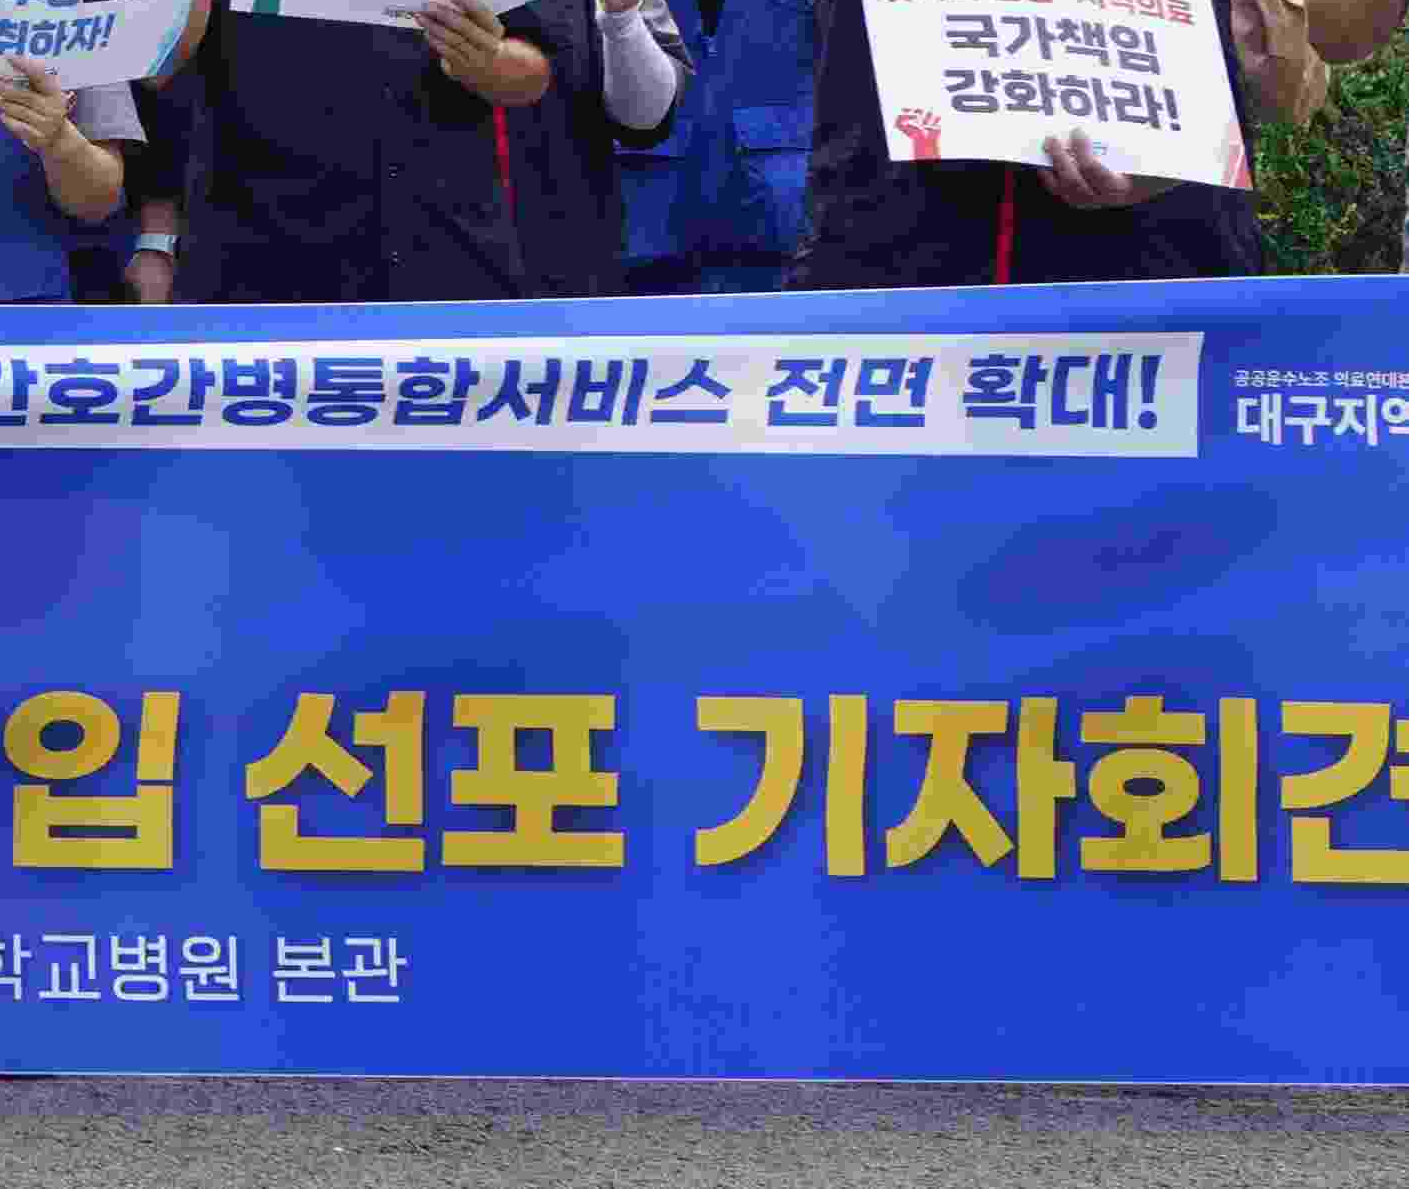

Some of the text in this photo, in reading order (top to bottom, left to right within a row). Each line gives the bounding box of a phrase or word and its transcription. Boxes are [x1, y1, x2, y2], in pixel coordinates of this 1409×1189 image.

[944, 12, 1160, 75] 국가책임
[943, 68, 1182, 132] 강화하라!
[762, 355, 934, 430] 전면
[961, 351, 1159, 433] 확대!
[1235, 370, 1329, 387] 공공운수노조
[245, 690, 624, 871] 선포
[273, 936, 406, 1004] 본관
